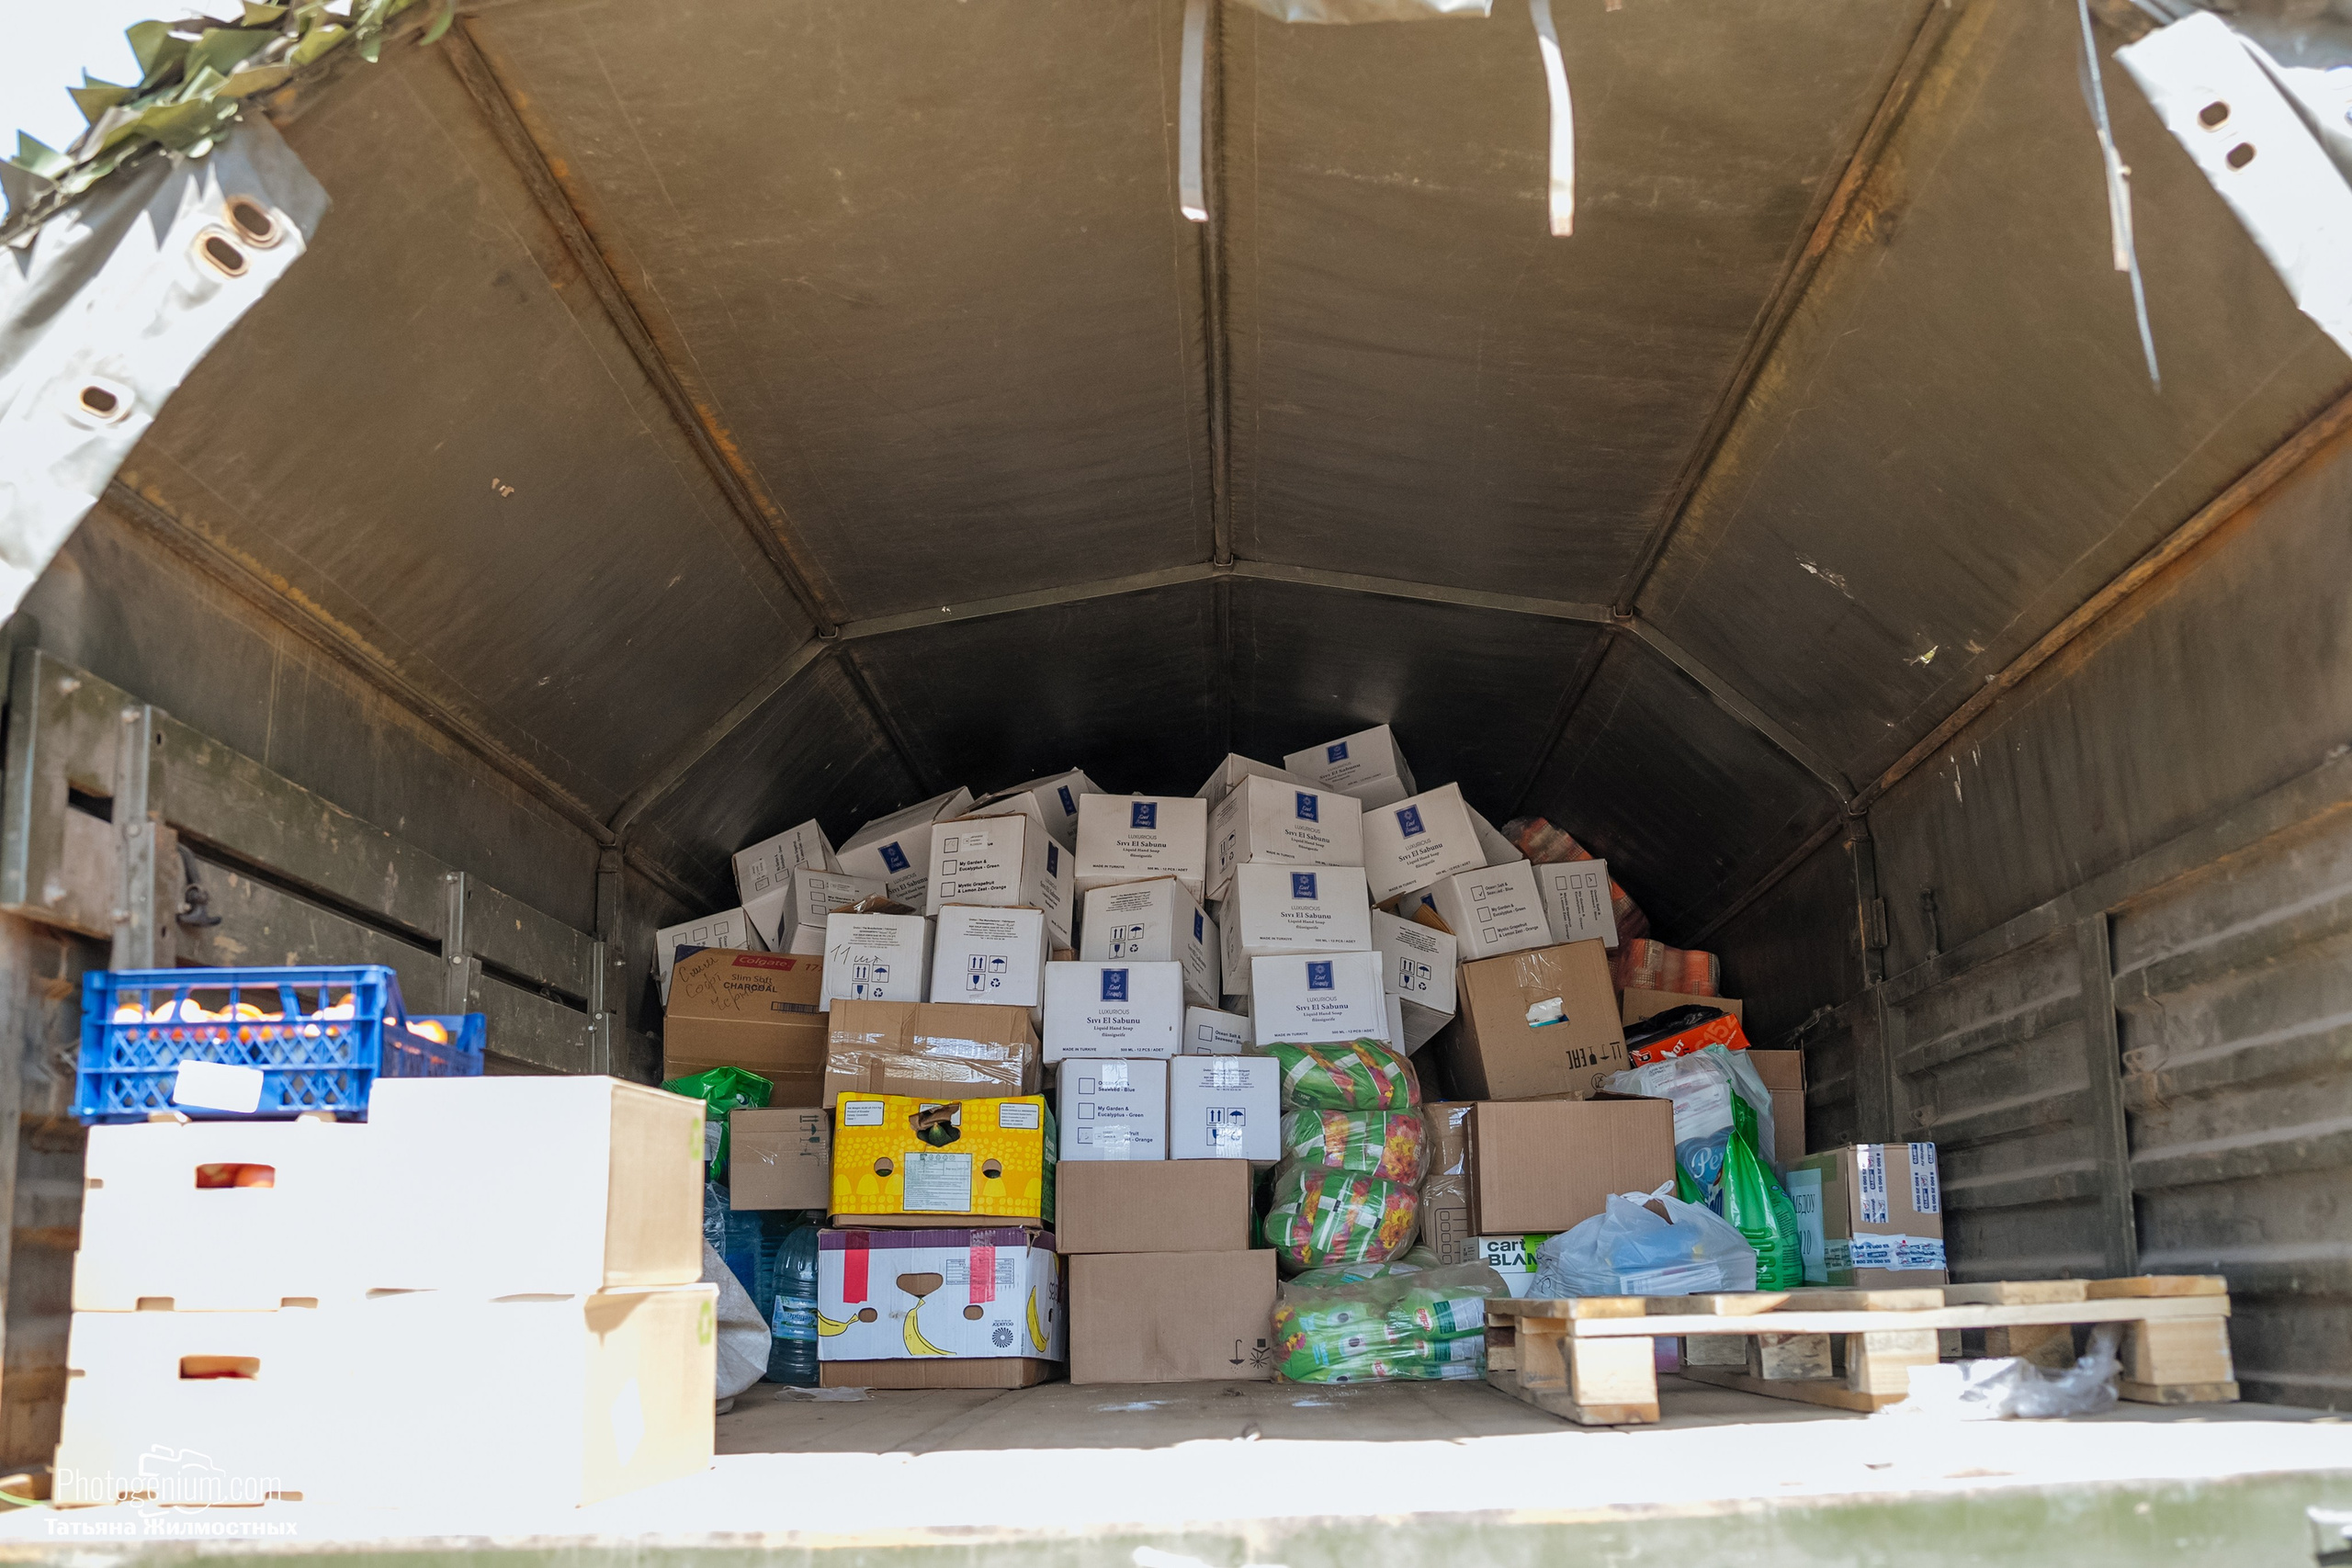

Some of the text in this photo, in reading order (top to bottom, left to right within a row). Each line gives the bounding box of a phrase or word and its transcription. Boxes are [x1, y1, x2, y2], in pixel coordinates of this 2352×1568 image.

[1405, 839, 1431, 851] LUXURIOUS
[1419, 843, 1442, 853] Sabunu
[739, 956, 787, 968] Colgate
[732, 974, 752, 982] Slim
[724, 982, 778, 993] CHARCOAL
[1488, 1253, 1538, 1266] BLAN
